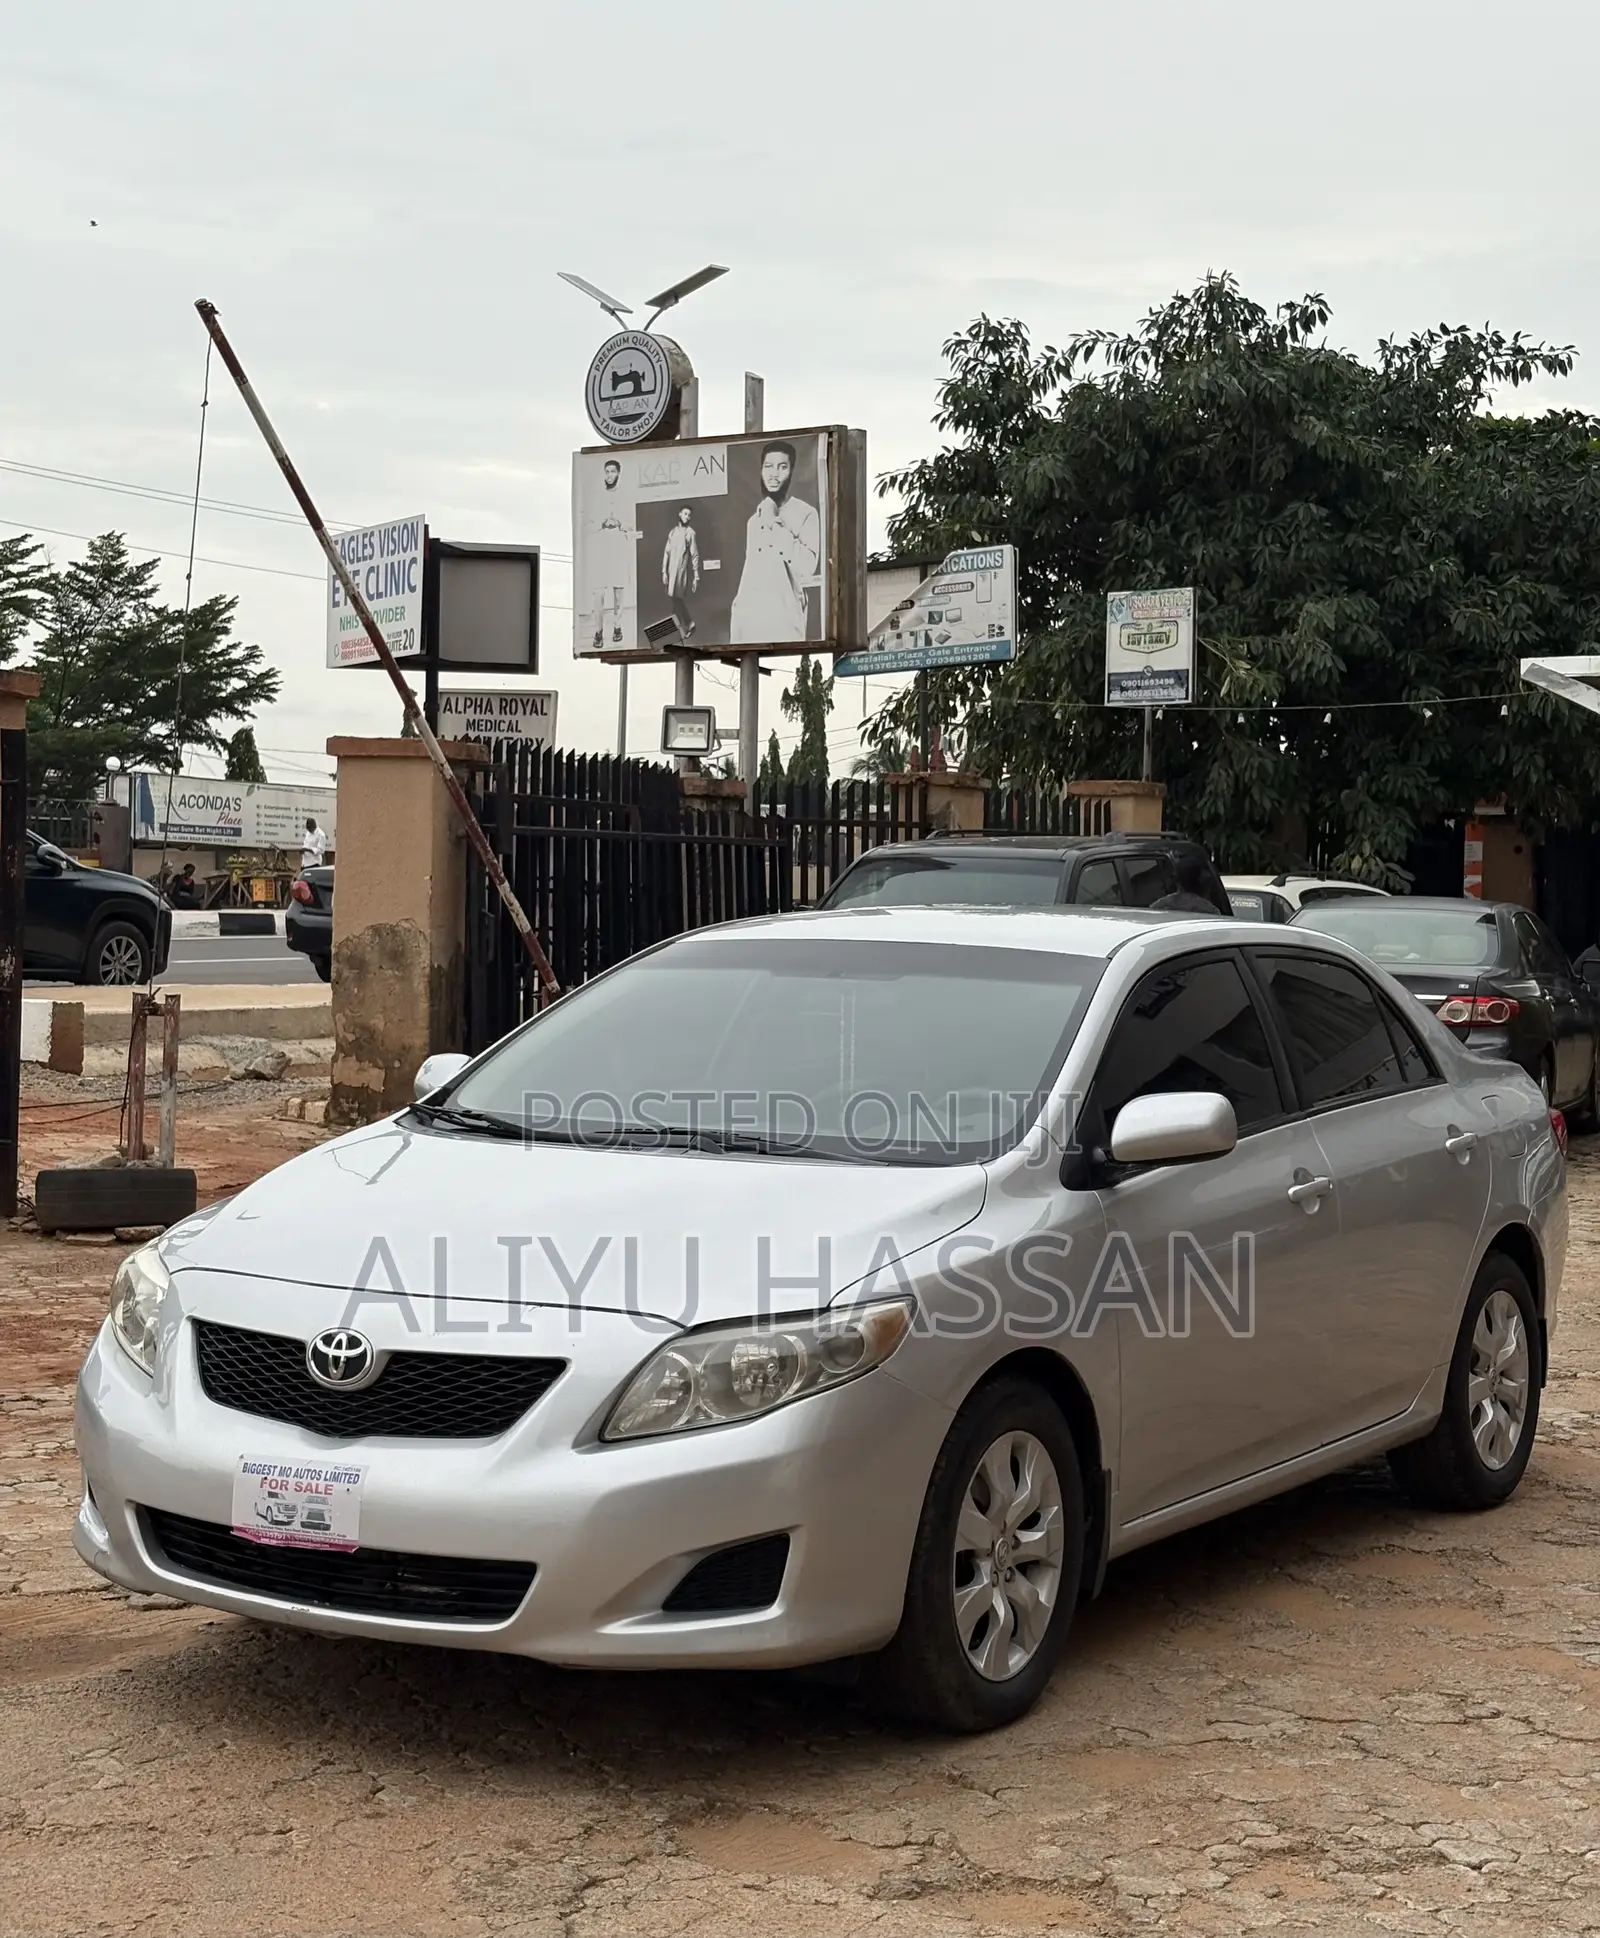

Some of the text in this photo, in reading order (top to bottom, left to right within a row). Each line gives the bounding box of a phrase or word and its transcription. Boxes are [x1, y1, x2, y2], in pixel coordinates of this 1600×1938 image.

[595, 336, 663, 372] PREMIUM QUALITY
[600, 412, 654, 437] TAILOR SHOP
[693, 454, 725, 476] AN
[334, 521, 419, 566] AGLES VISION
[366, 557, 418, 602] CLINIC
[934, 582, 972, 595] ACCESSORIES
[340, 606, 406, 632] NHIS OVIDER
[387, 627, 415, 653] UITE 20
[928, 649, 951, 657] Gate
[954, 644, 997, 654] Entrance
[443, 697, 548, 716] ALPHA ROYAL
[466, 719, 522, 733] MEDICAL
[216, 812, 243, 825] Place
[242, 1462, 360, 1485] BIGGEST MO AUTOS LIMITED
[260, 1477, 334, 1496] FOR SALE
